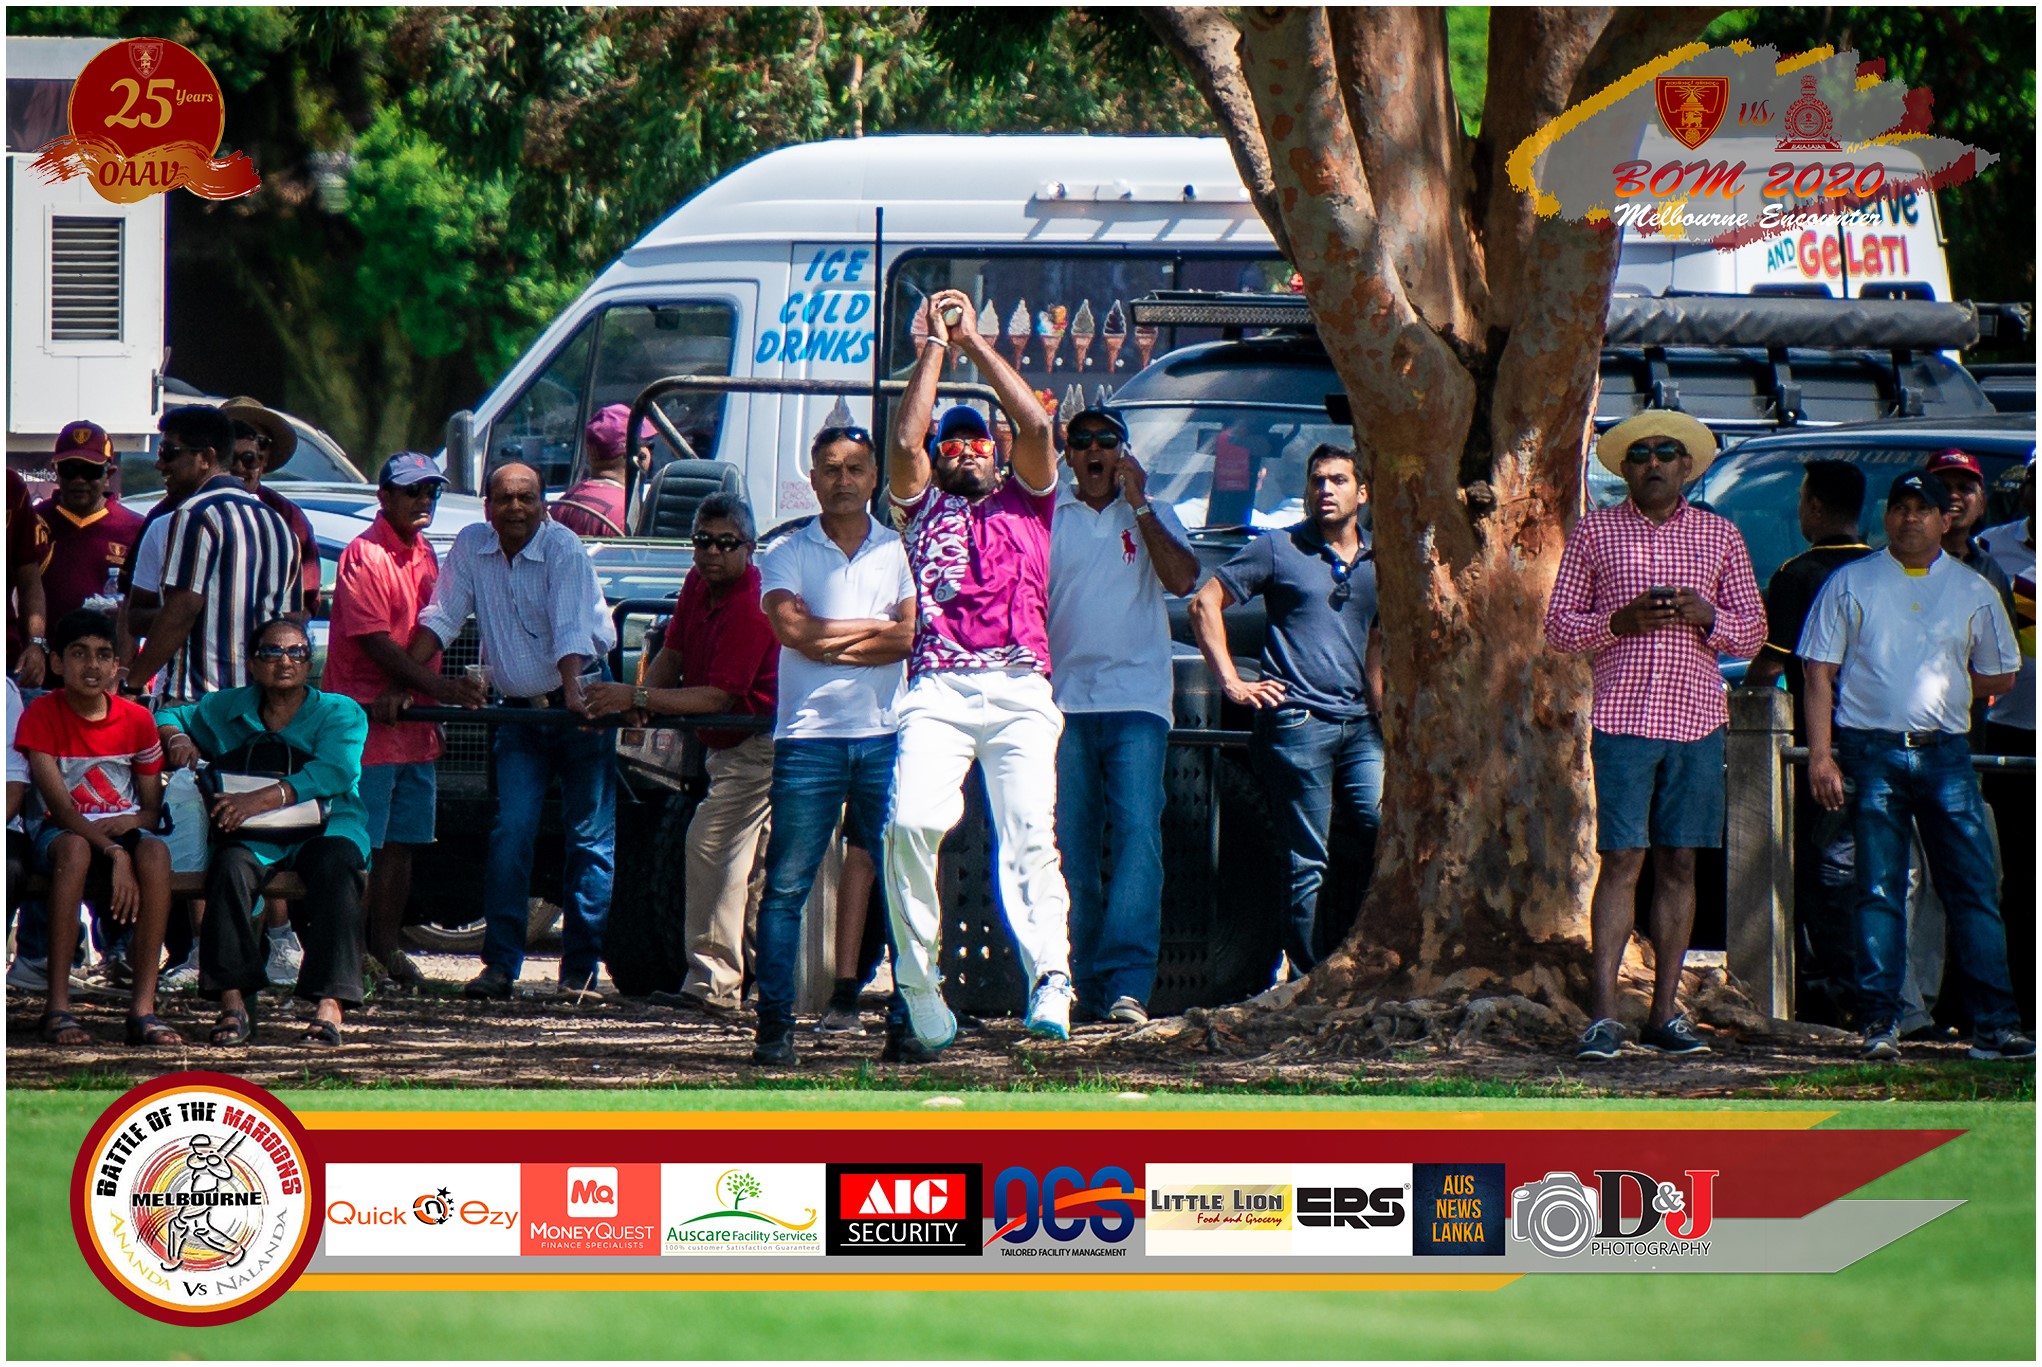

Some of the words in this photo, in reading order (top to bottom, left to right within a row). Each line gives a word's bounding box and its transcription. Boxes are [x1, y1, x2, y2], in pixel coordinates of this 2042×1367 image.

[804, 248, 870, 282] ICE
[1767, 237, 1796, 272] AND
[779, 290, 871, 324] COLD
[755, 329, 876, 363] DRINKS
